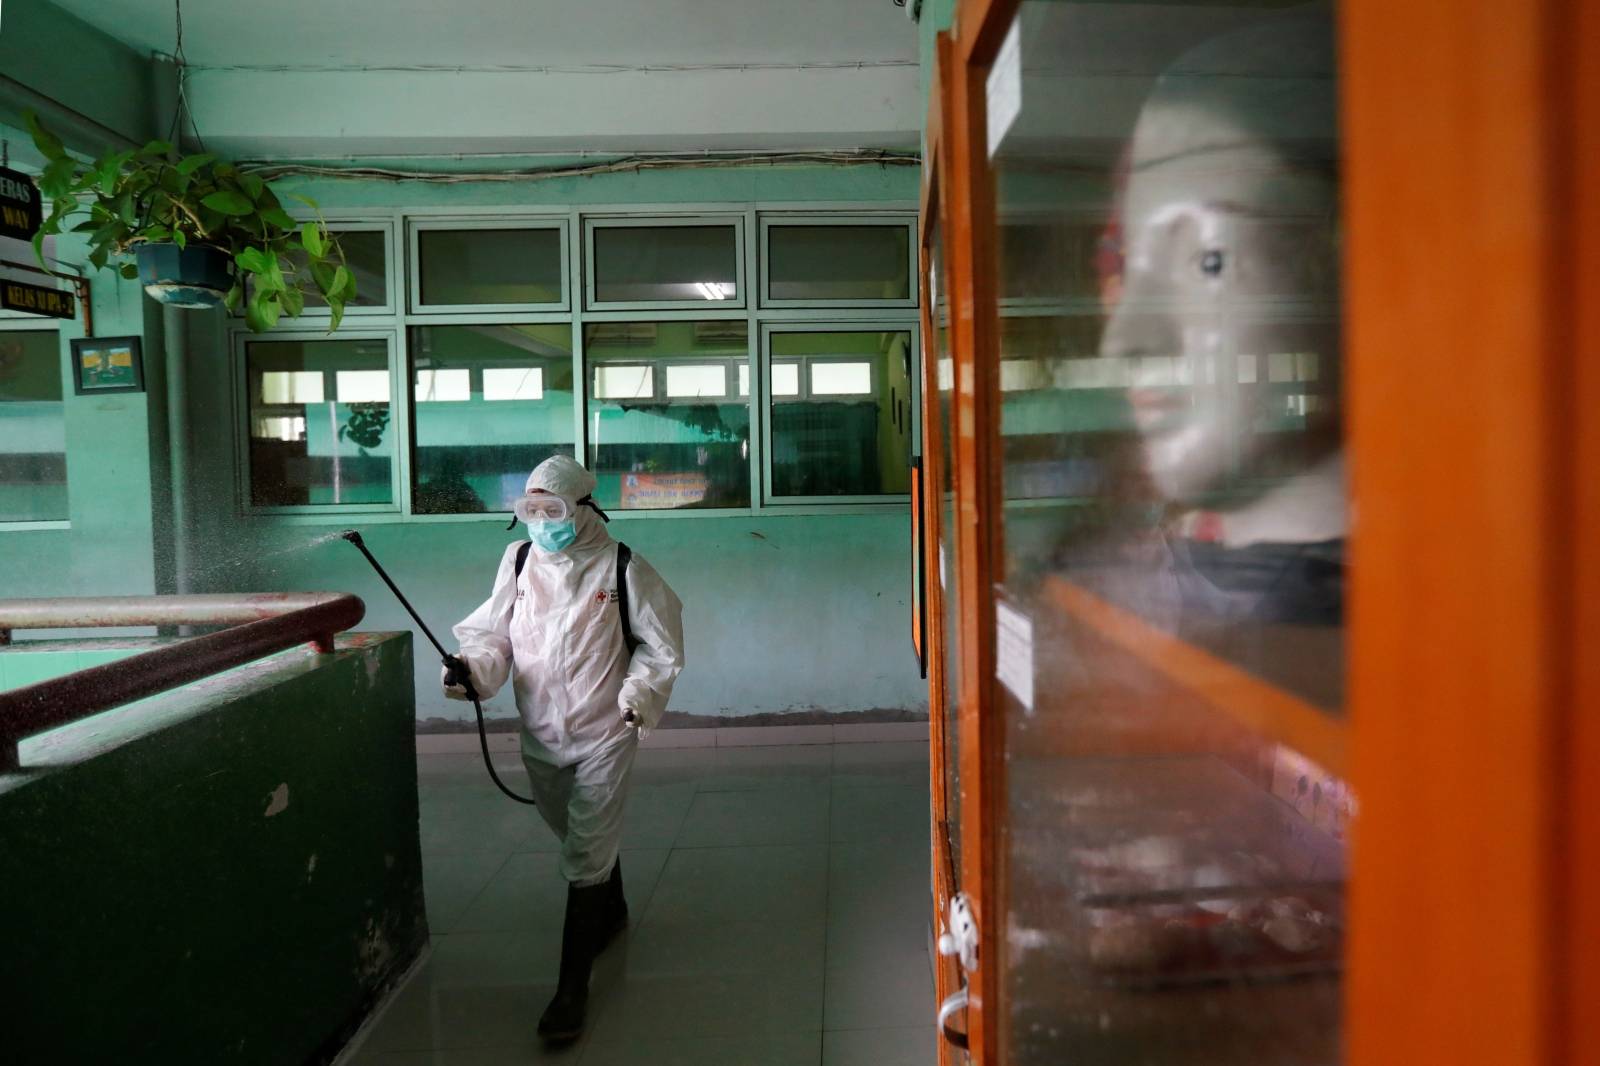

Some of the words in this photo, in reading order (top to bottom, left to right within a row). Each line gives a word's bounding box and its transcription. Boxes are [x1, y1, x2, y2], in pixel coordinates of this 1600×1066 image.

[2, 205, 30, 230] WAY
[7, 285, 36, 308] KELAS
[47, 291, 62, 315] IPA
[66, 295, 73, 314] 2
